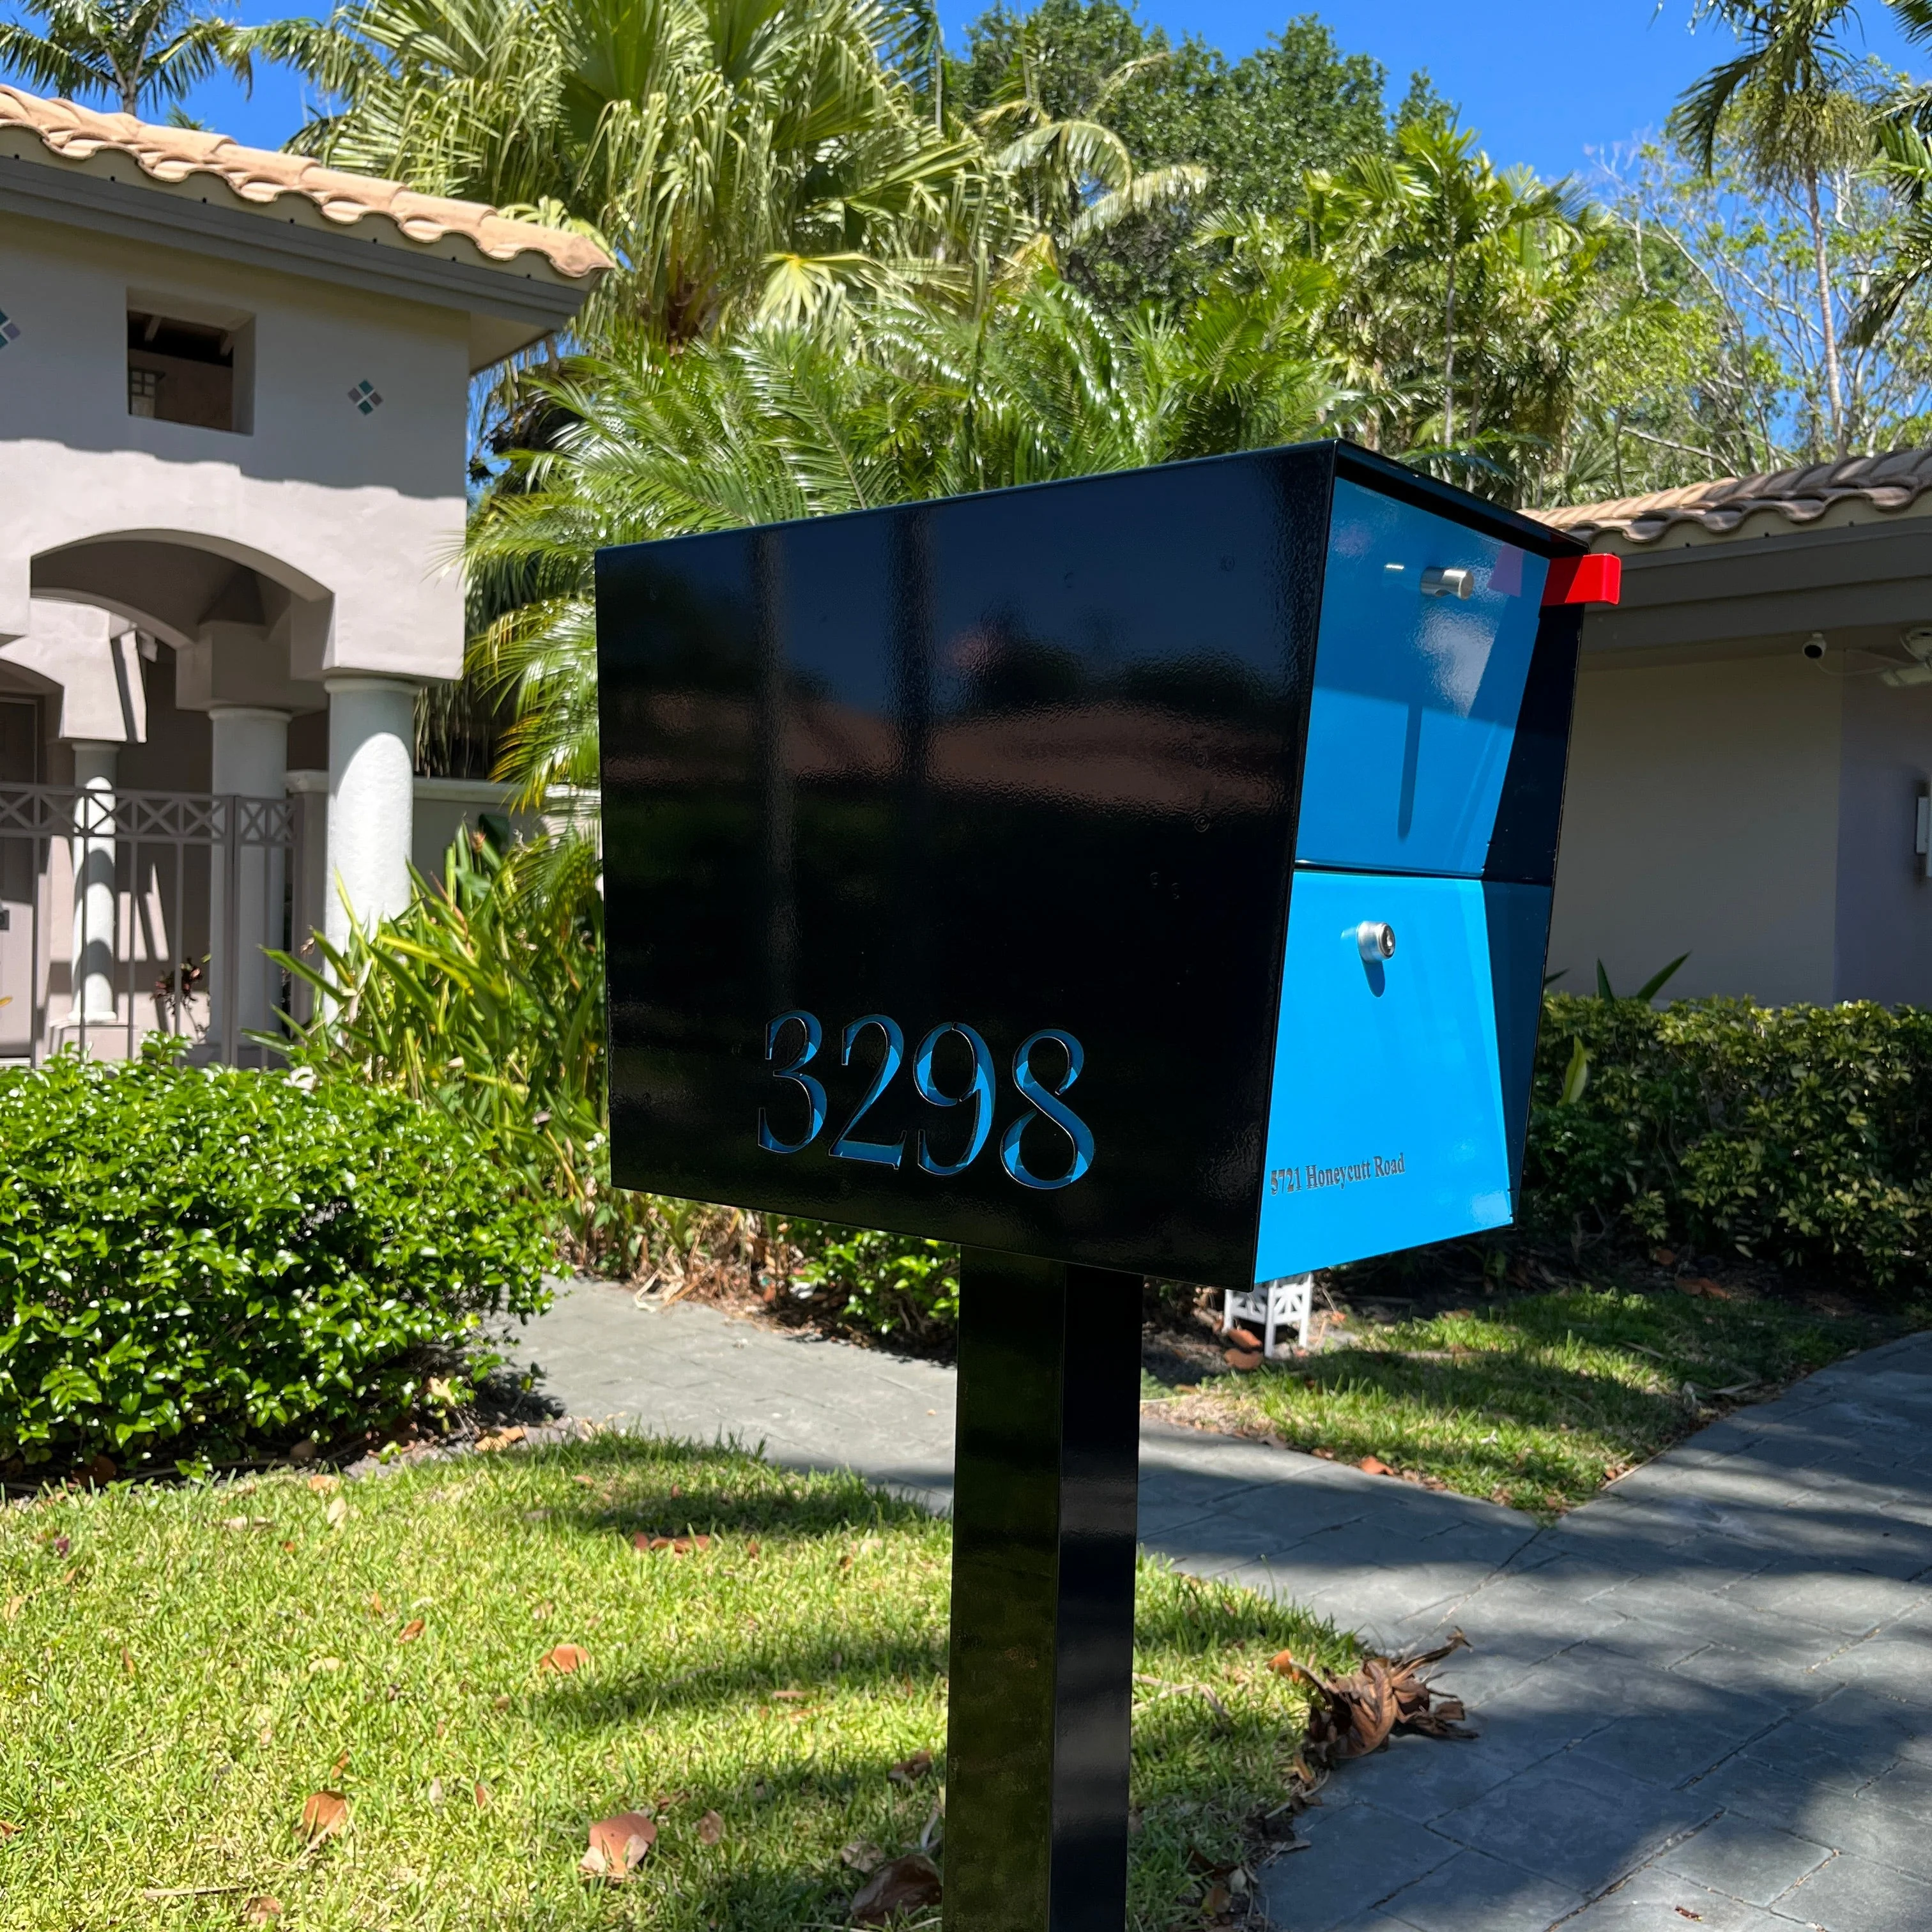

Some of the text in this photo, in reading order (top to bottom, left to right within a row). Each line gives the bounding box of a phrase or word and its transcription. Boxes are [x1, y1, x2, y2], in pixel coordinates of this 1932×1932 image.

[758, 1009, 1094, 1190] 3298
[1270, 1152, 1406, 1195] 5721 Honeycutt Road
